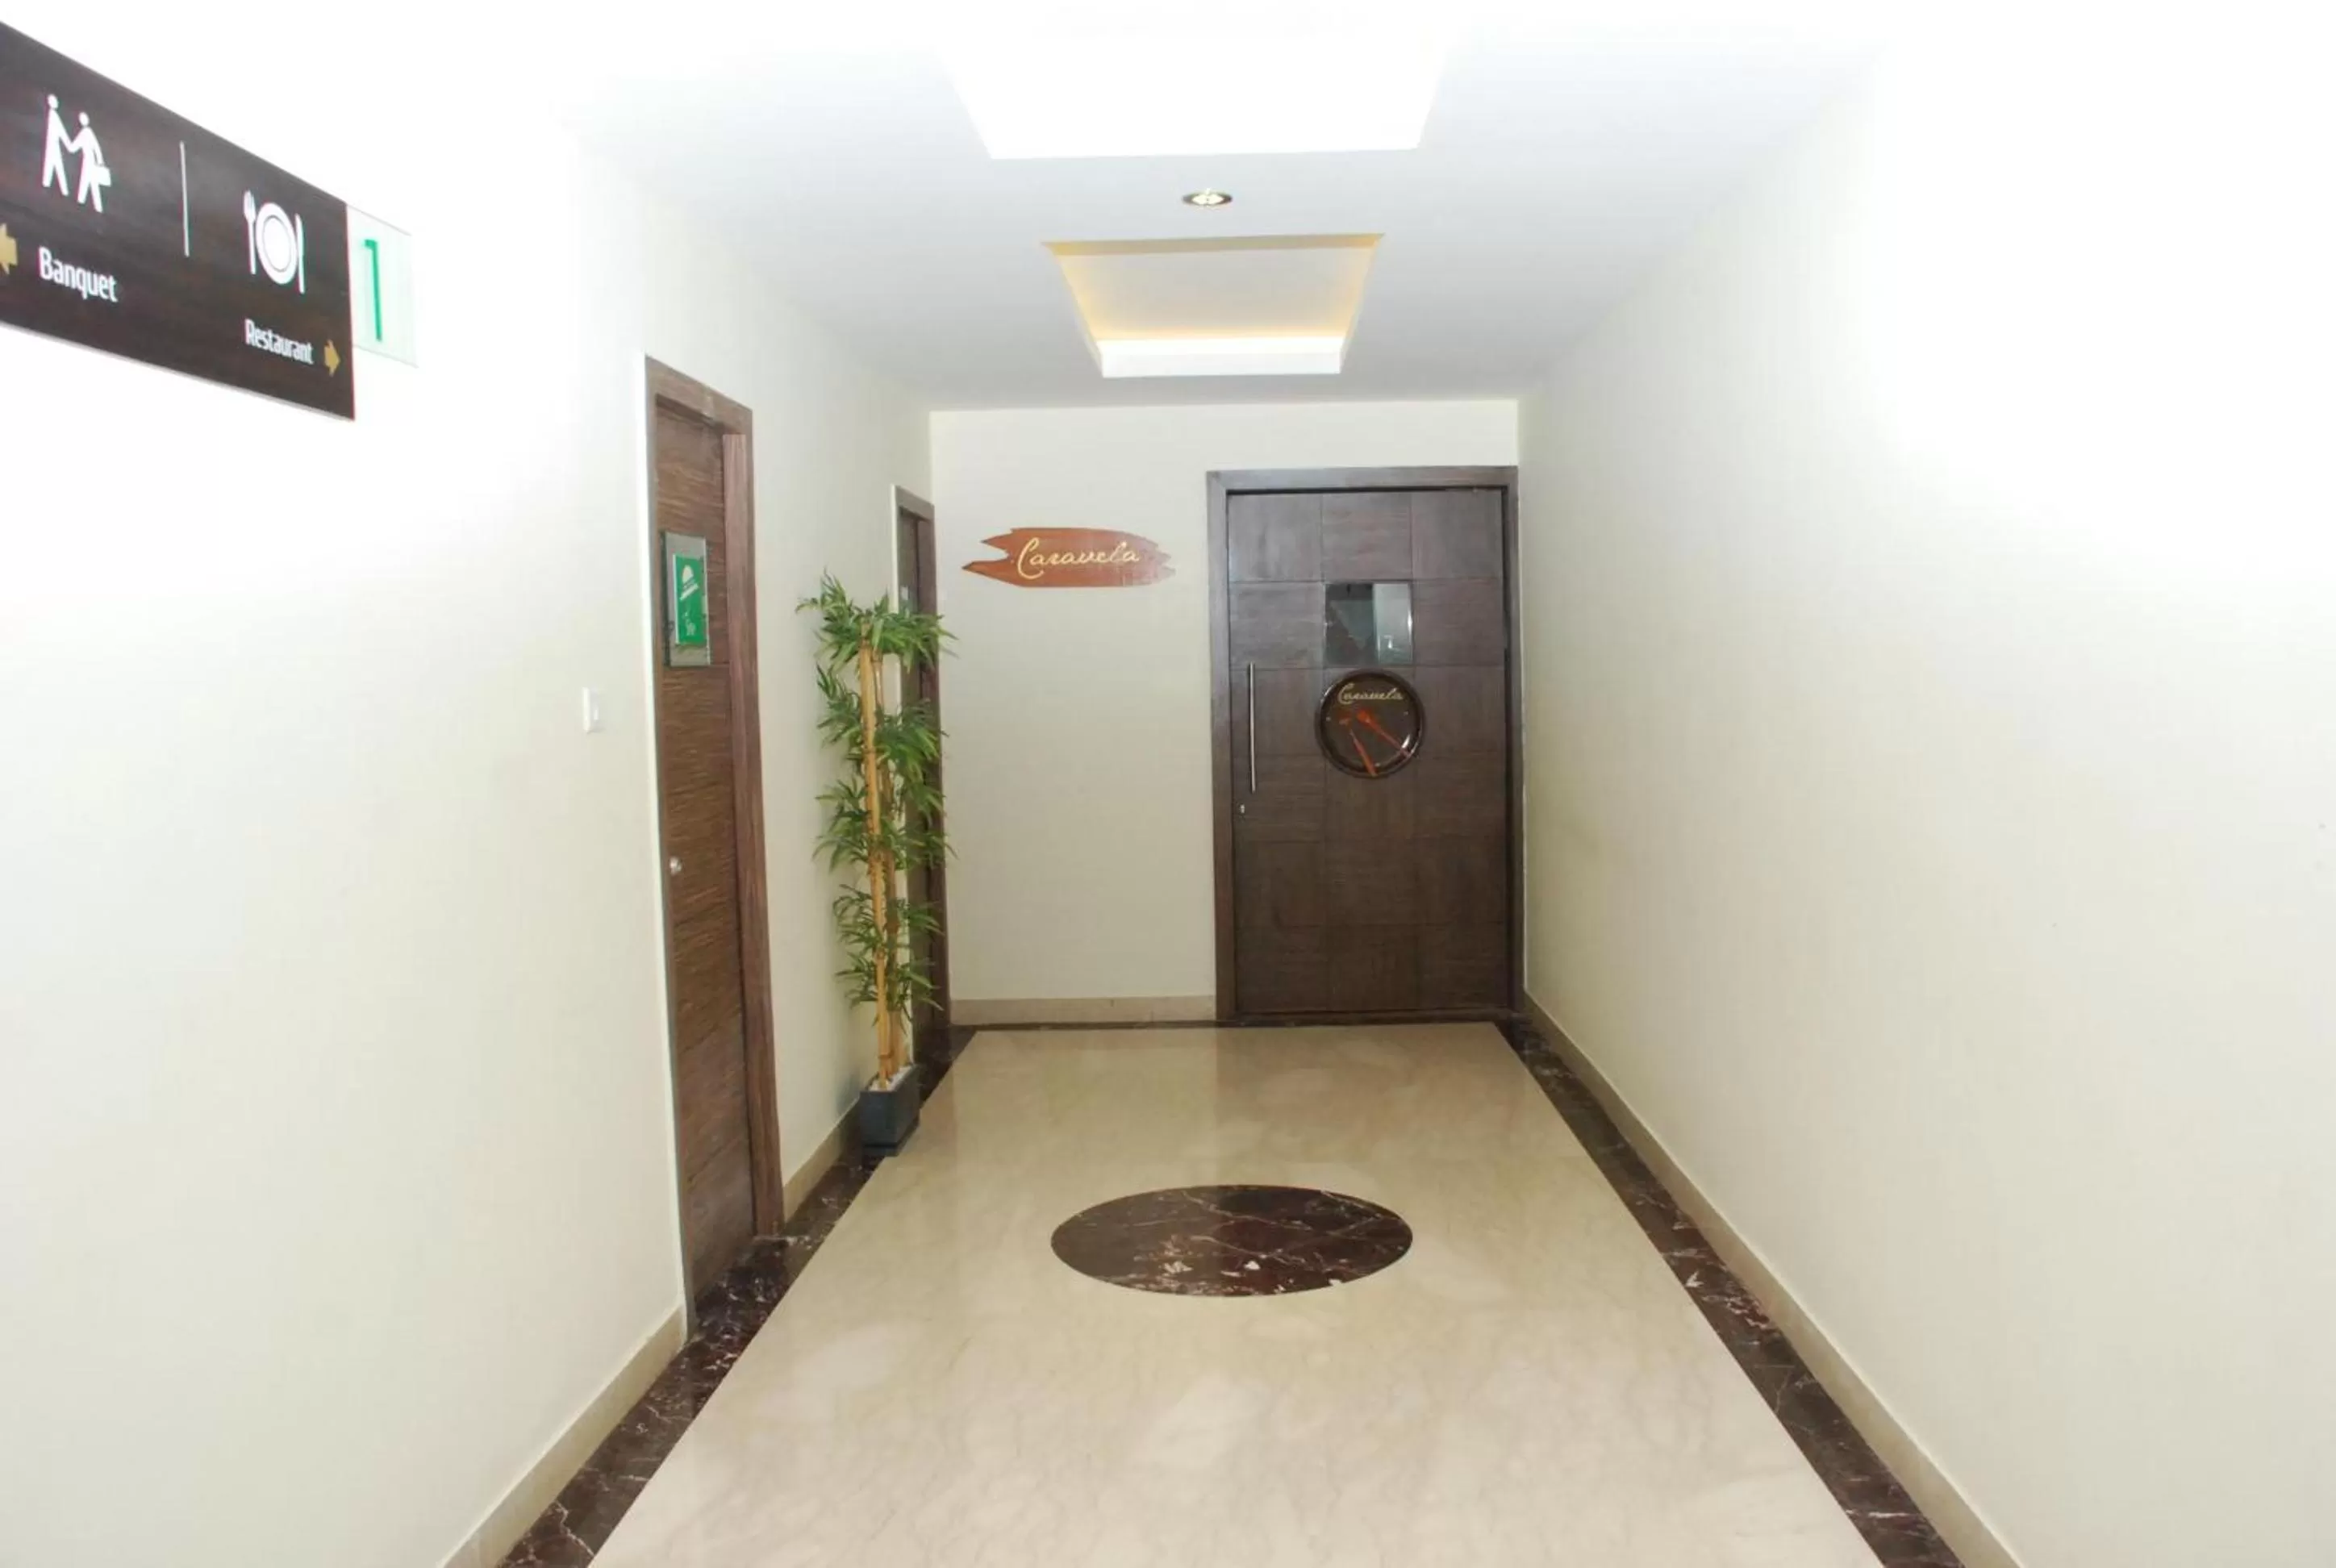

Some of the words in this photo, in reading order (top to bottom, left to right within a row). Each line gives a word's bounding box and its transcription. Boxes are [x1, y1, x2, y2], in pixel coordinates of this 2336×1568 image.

[39, 246, 118, 302] Banquet
[363, 239, 382, 342] 1
[245, 319, 314, 365] Restaurant
[1017, 536, 1140, 579] Caravela
